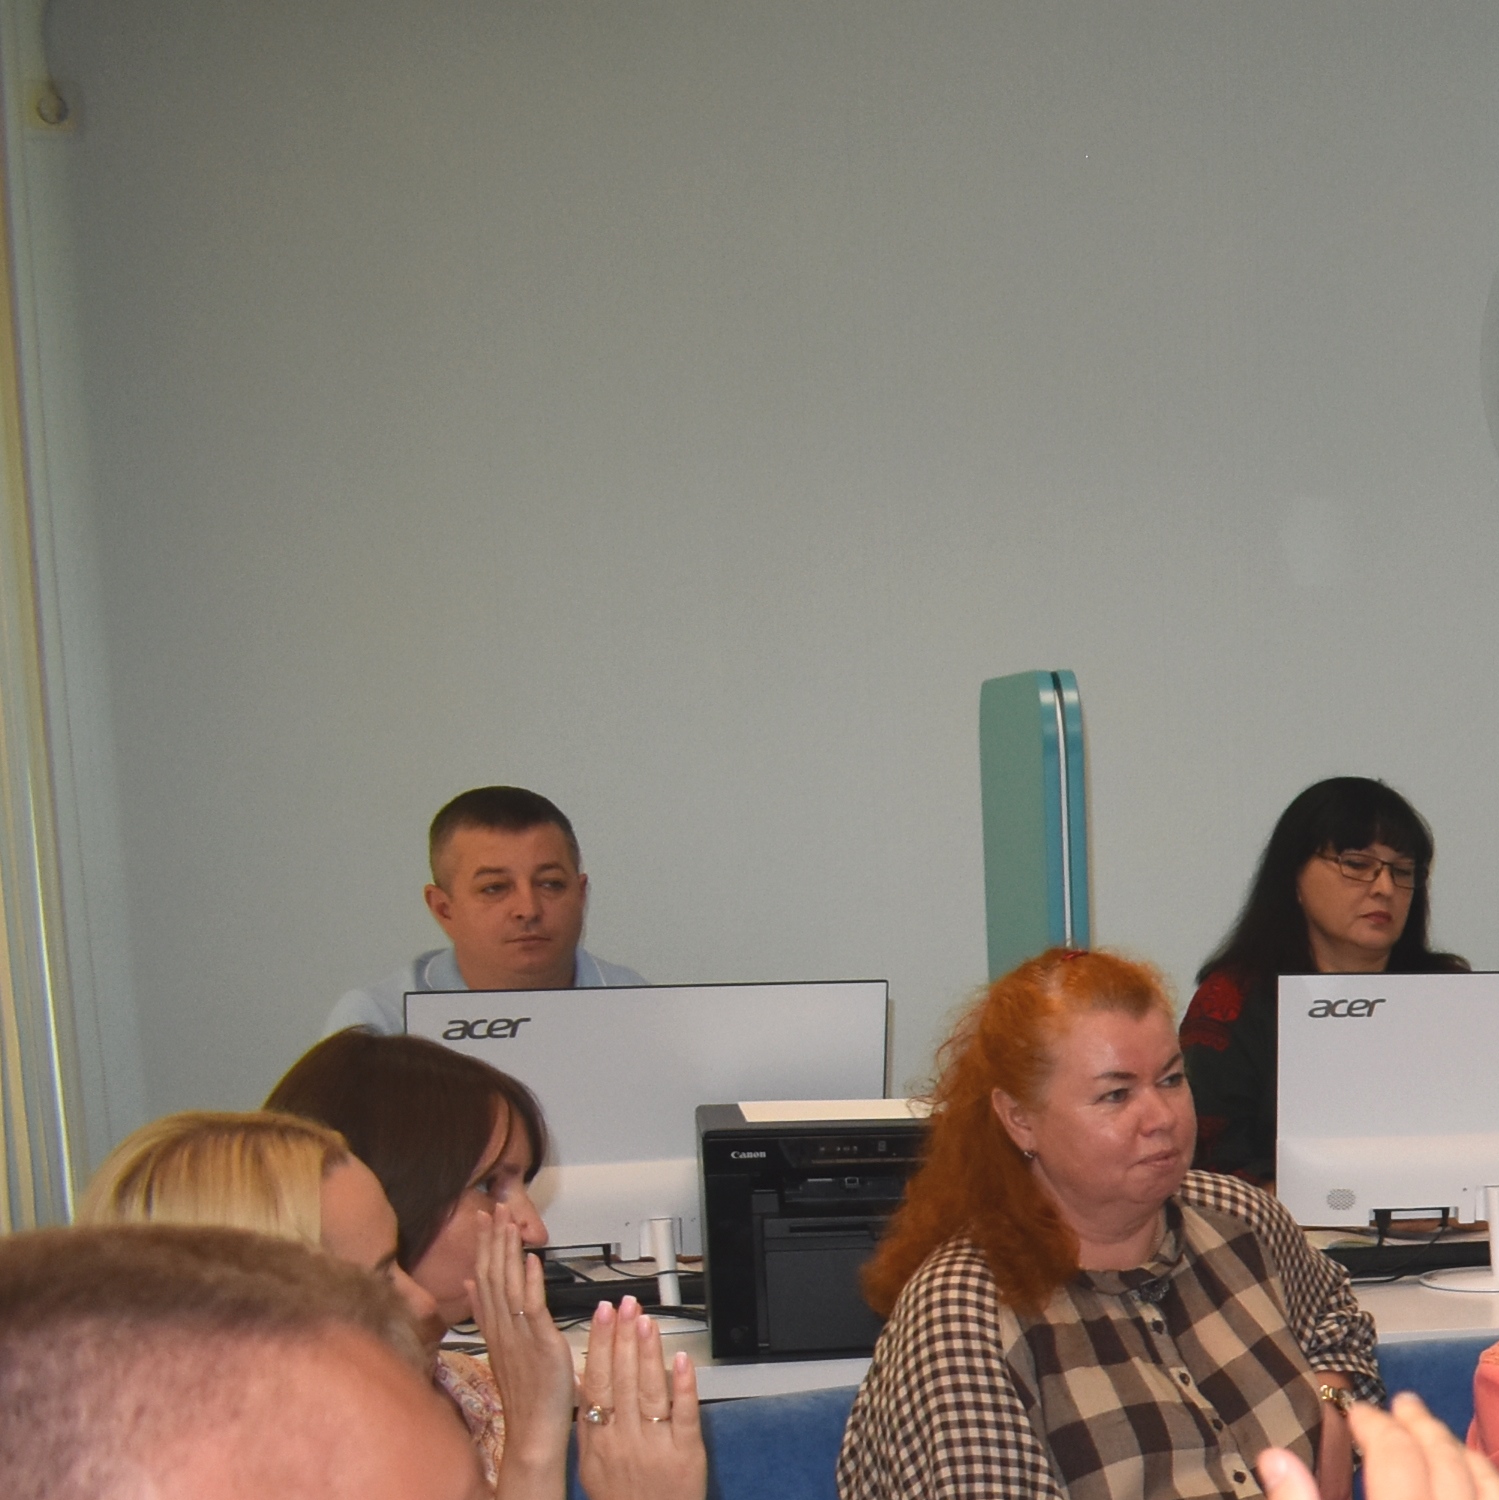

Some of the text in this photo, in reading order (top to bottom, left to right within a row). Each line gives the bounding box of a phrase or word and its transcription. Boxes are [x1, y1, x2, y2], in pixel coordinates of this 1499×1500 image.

[1307, 998, 1387, 1019] acer
[442, 1017, 532, 1041] acer
[730, 1150, 767, 1159] Canon
